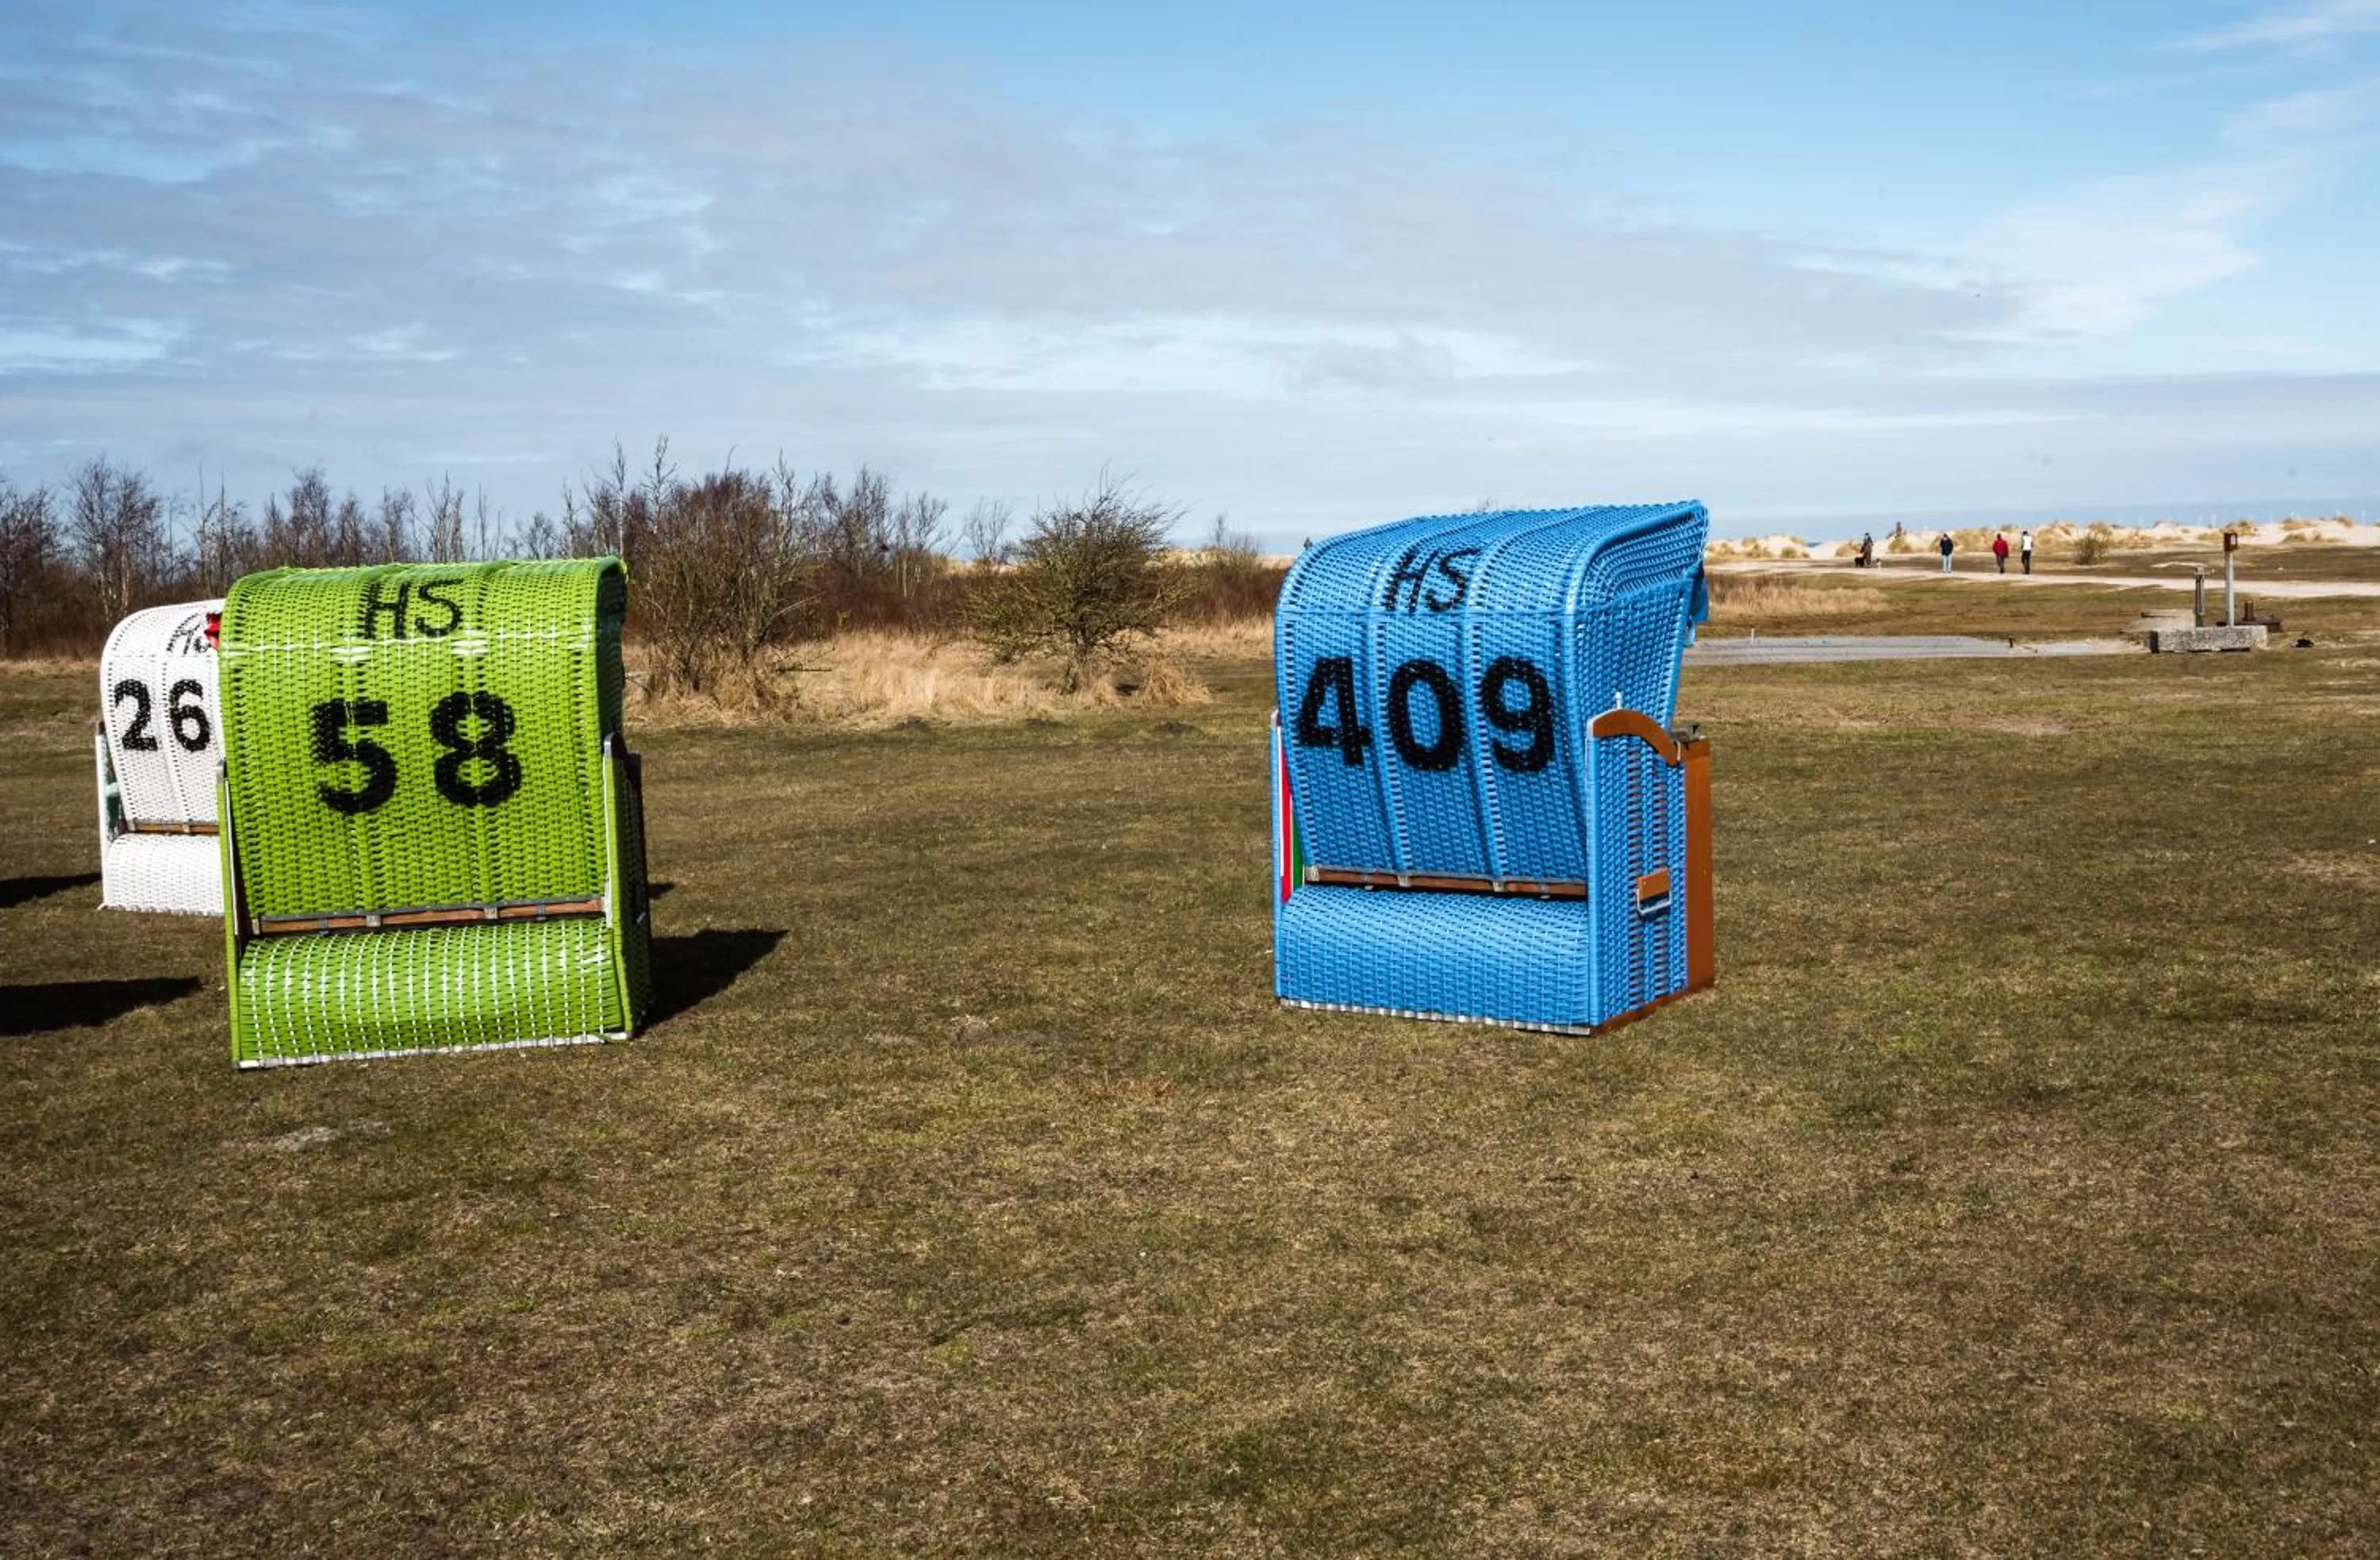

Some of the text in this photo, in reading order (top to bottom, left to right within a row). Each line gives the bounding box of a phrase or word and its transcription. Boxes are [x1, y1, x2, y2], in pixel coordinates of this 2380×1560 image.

[363, 578, 463, 640] HS
[1384, 546, 1480, 614] HS
[310, 690, 523, 815] 58
[1297, 655, 1556, 774] 409
